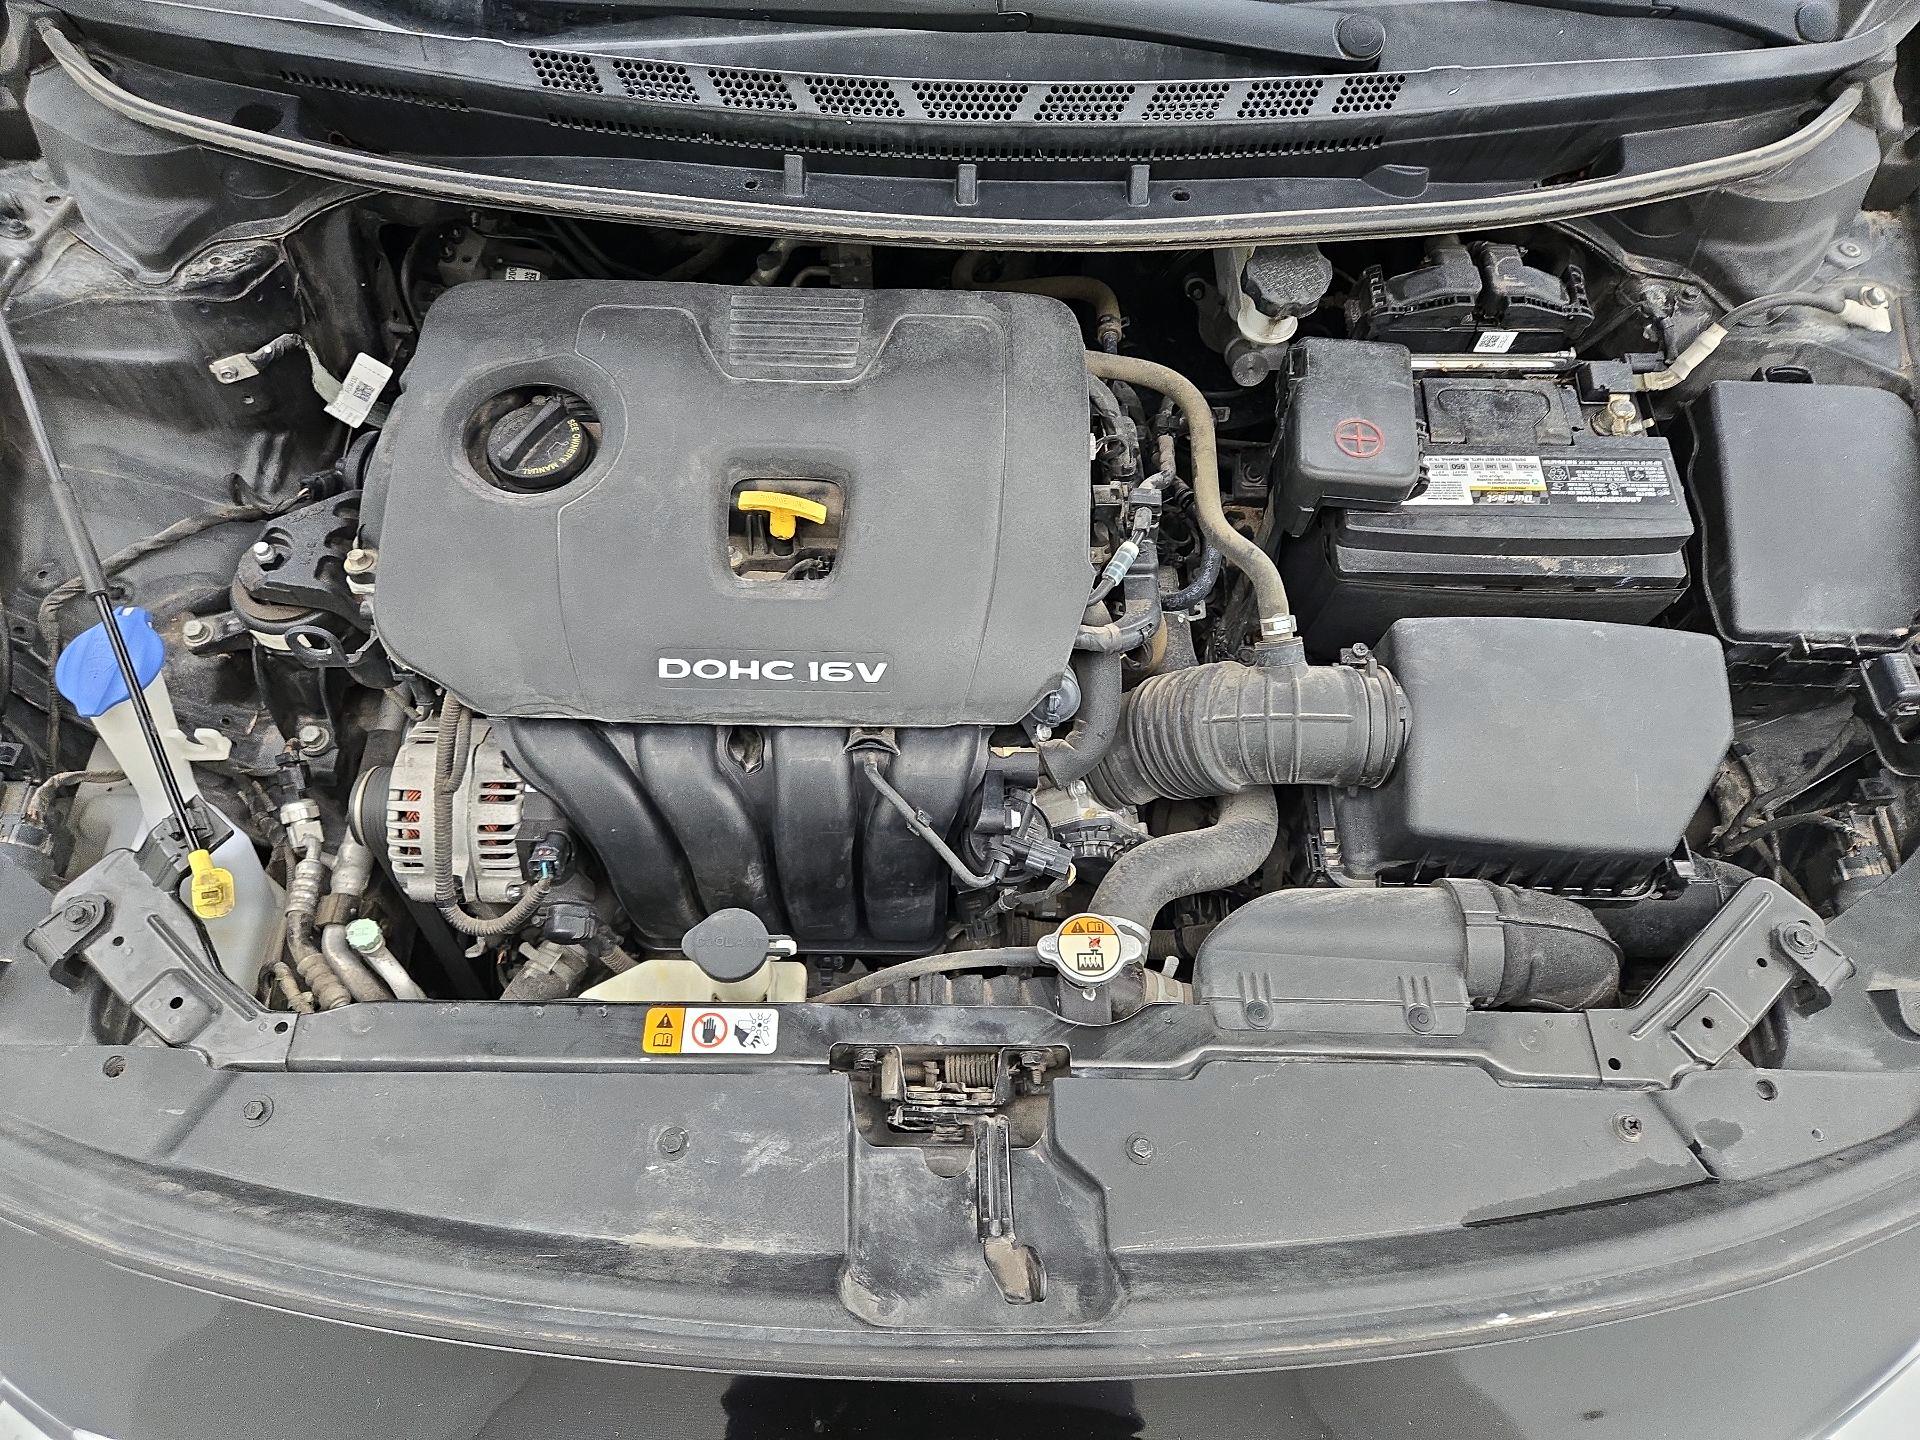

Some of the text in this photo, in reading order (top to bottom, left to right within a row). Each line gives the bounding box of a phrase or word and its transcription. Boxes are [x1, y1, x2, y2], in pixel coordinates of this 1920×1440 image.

[522, 418, 582, 475] SEE OWNER'S MANUAL
[1486, 494, 1536, 503] Duralast
[658, 657, 888, 683] DOHC 16V
